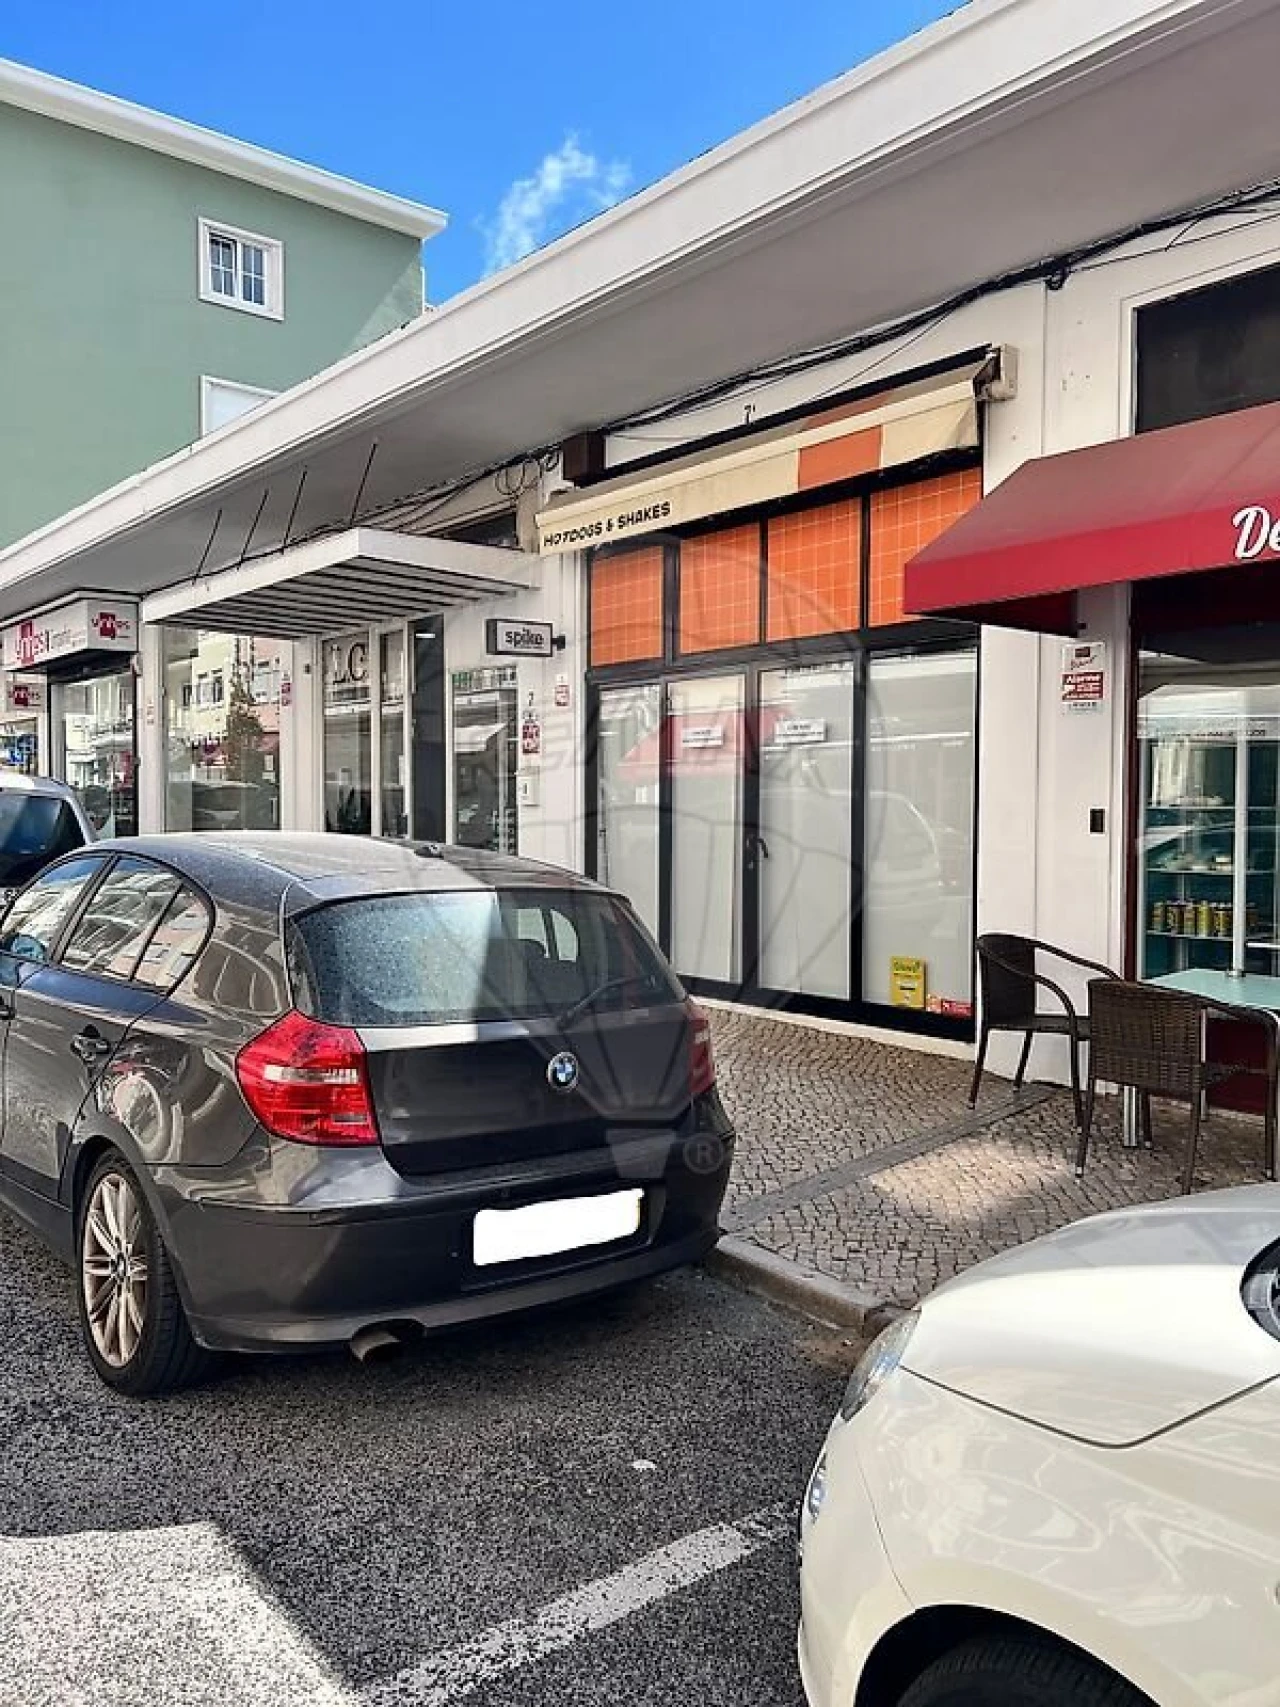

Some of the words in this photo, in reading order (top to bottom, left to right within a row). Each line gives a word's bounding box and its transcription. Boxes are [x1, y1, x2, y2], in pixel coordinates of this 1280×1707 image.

[543, 522, 603, 547] HOTDOGS
[606, 518, 615, 532] &
[618, 501, 672, 529] SHAKES
[504, 626, 545, 648] spike
